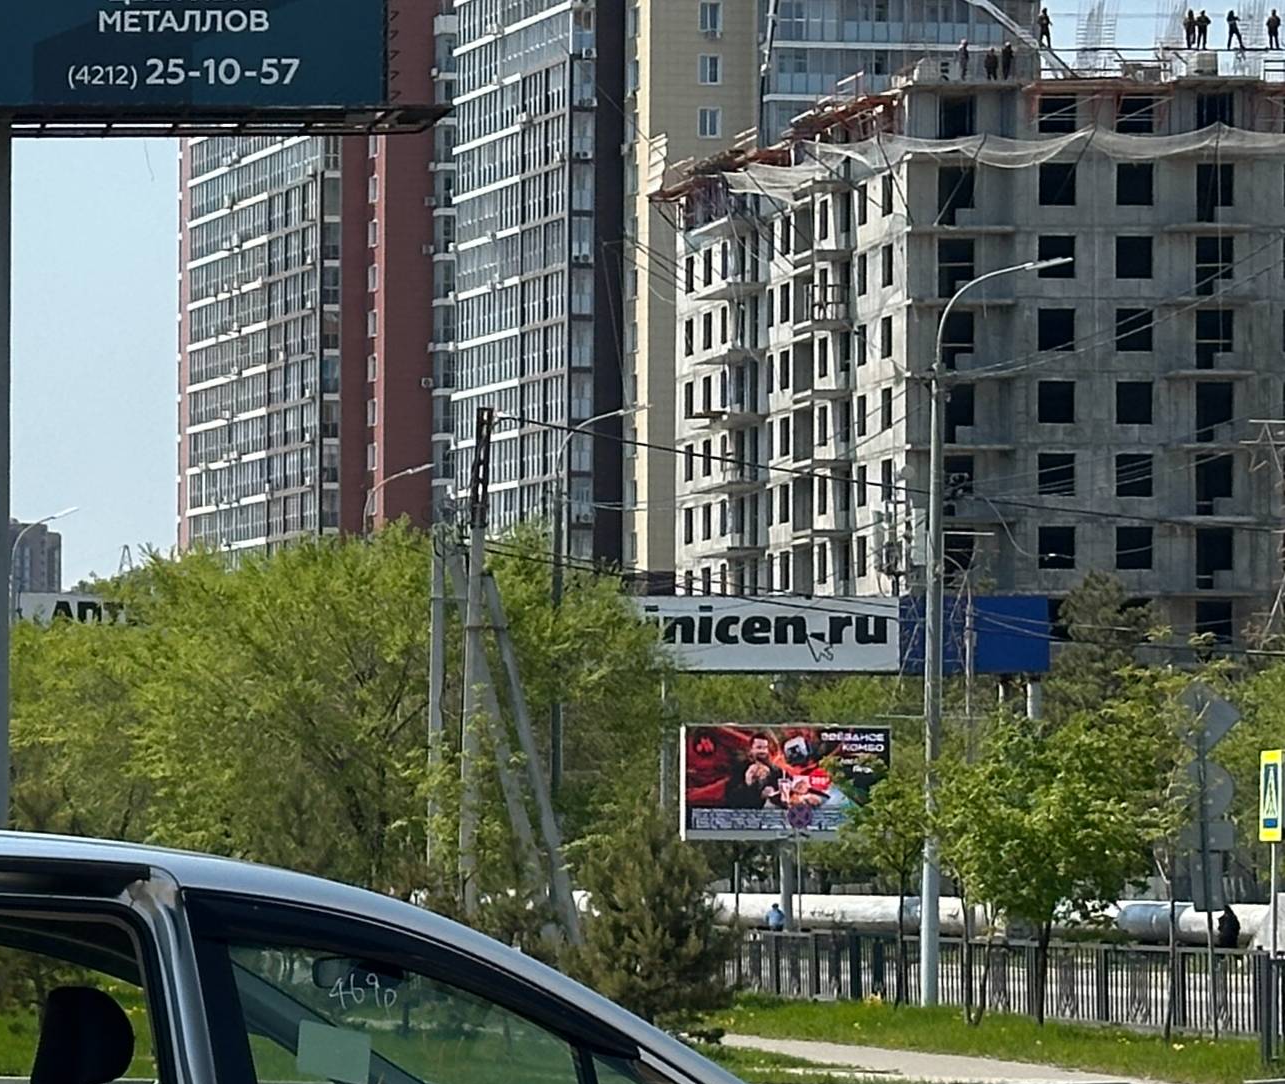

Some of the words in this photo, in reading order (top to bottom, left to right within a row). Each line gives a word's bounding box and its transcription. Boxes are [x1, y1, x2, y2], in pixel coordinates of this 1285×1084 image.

[98, 9, 270, 33] МЕТАЛЛОВ
[67, 65, 138, 90] (4212)
[145, 58, 301, 86] 25-10-57
